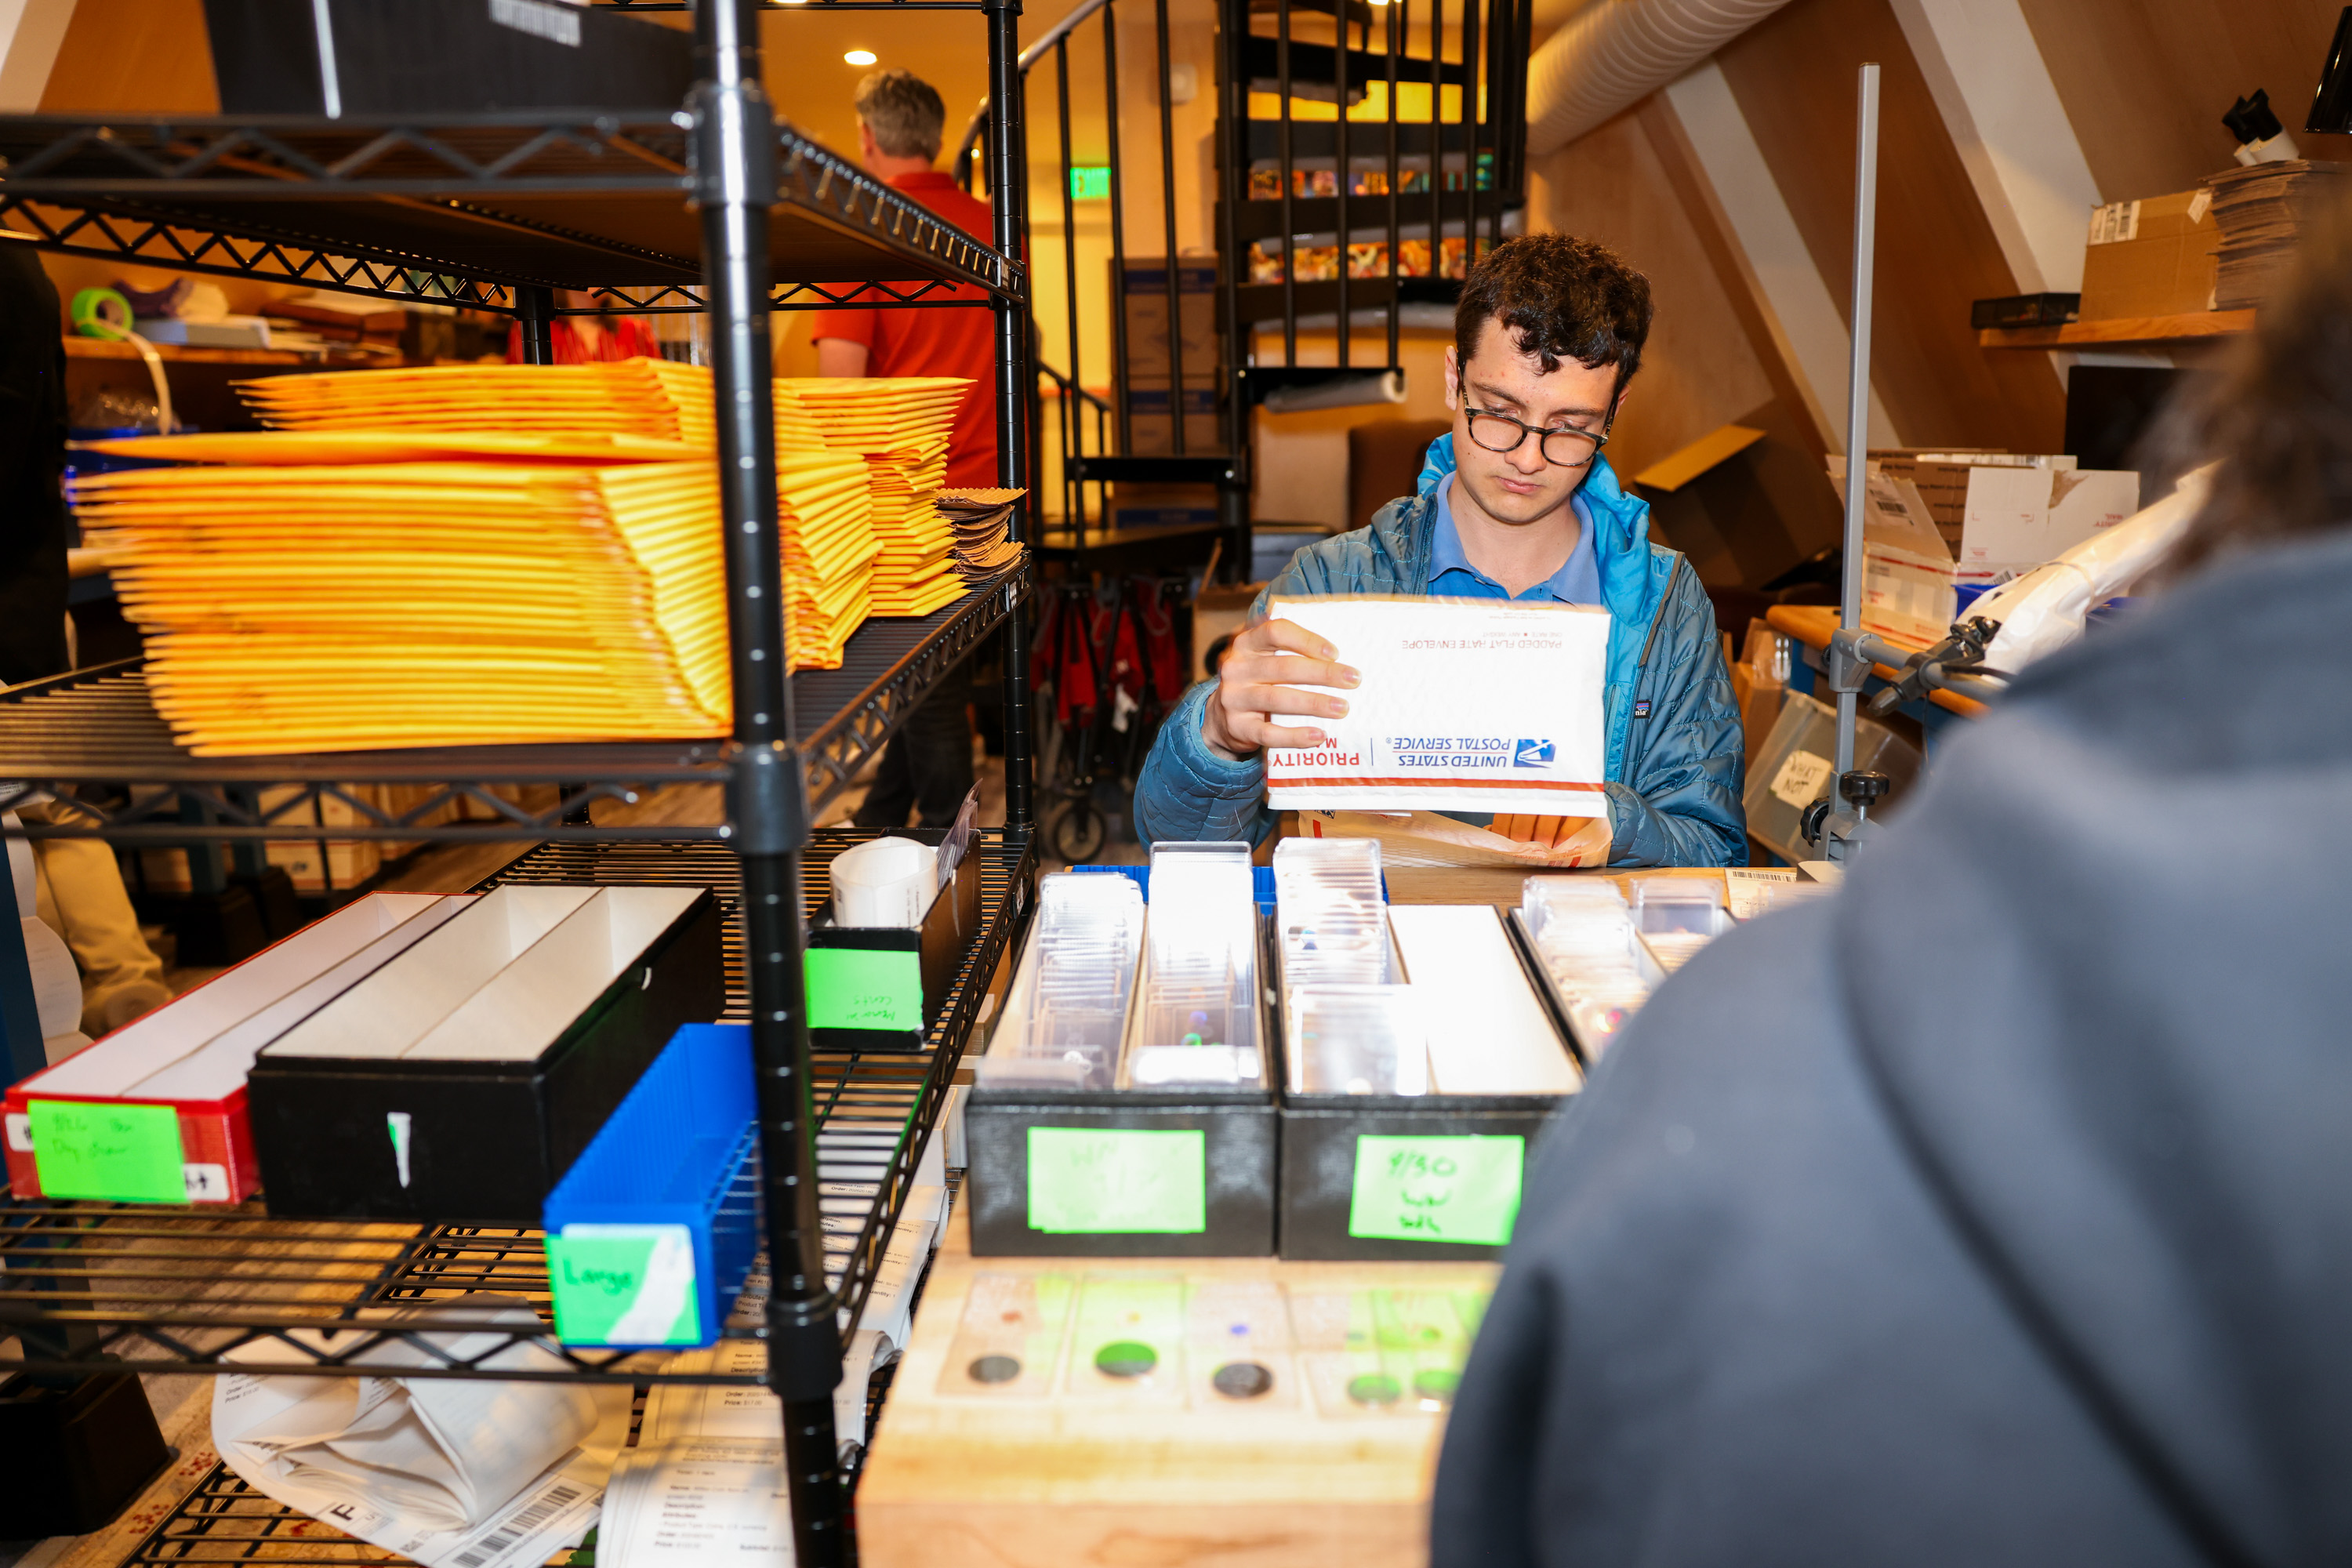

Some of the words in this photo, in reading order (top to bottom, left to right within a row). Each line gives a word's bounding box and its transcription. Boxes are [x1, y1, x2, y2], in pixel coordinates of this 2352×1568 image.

[1402, 640, 1456, 649] ENVELOPE
[1460, 640, 1486, 649] RATE
[1489, 640, 1515, 649] FLAT
[1518, 640, 1562, 649] PADDED
[1457, 739, 1512, 750] POSTAL
[1399, 756, 1449, 767] STATES
[1451, 756, 1507, 768] UNITED
[1781, 777, 1809, 795] NOT
[562, 1257, 633, 1297] Large
